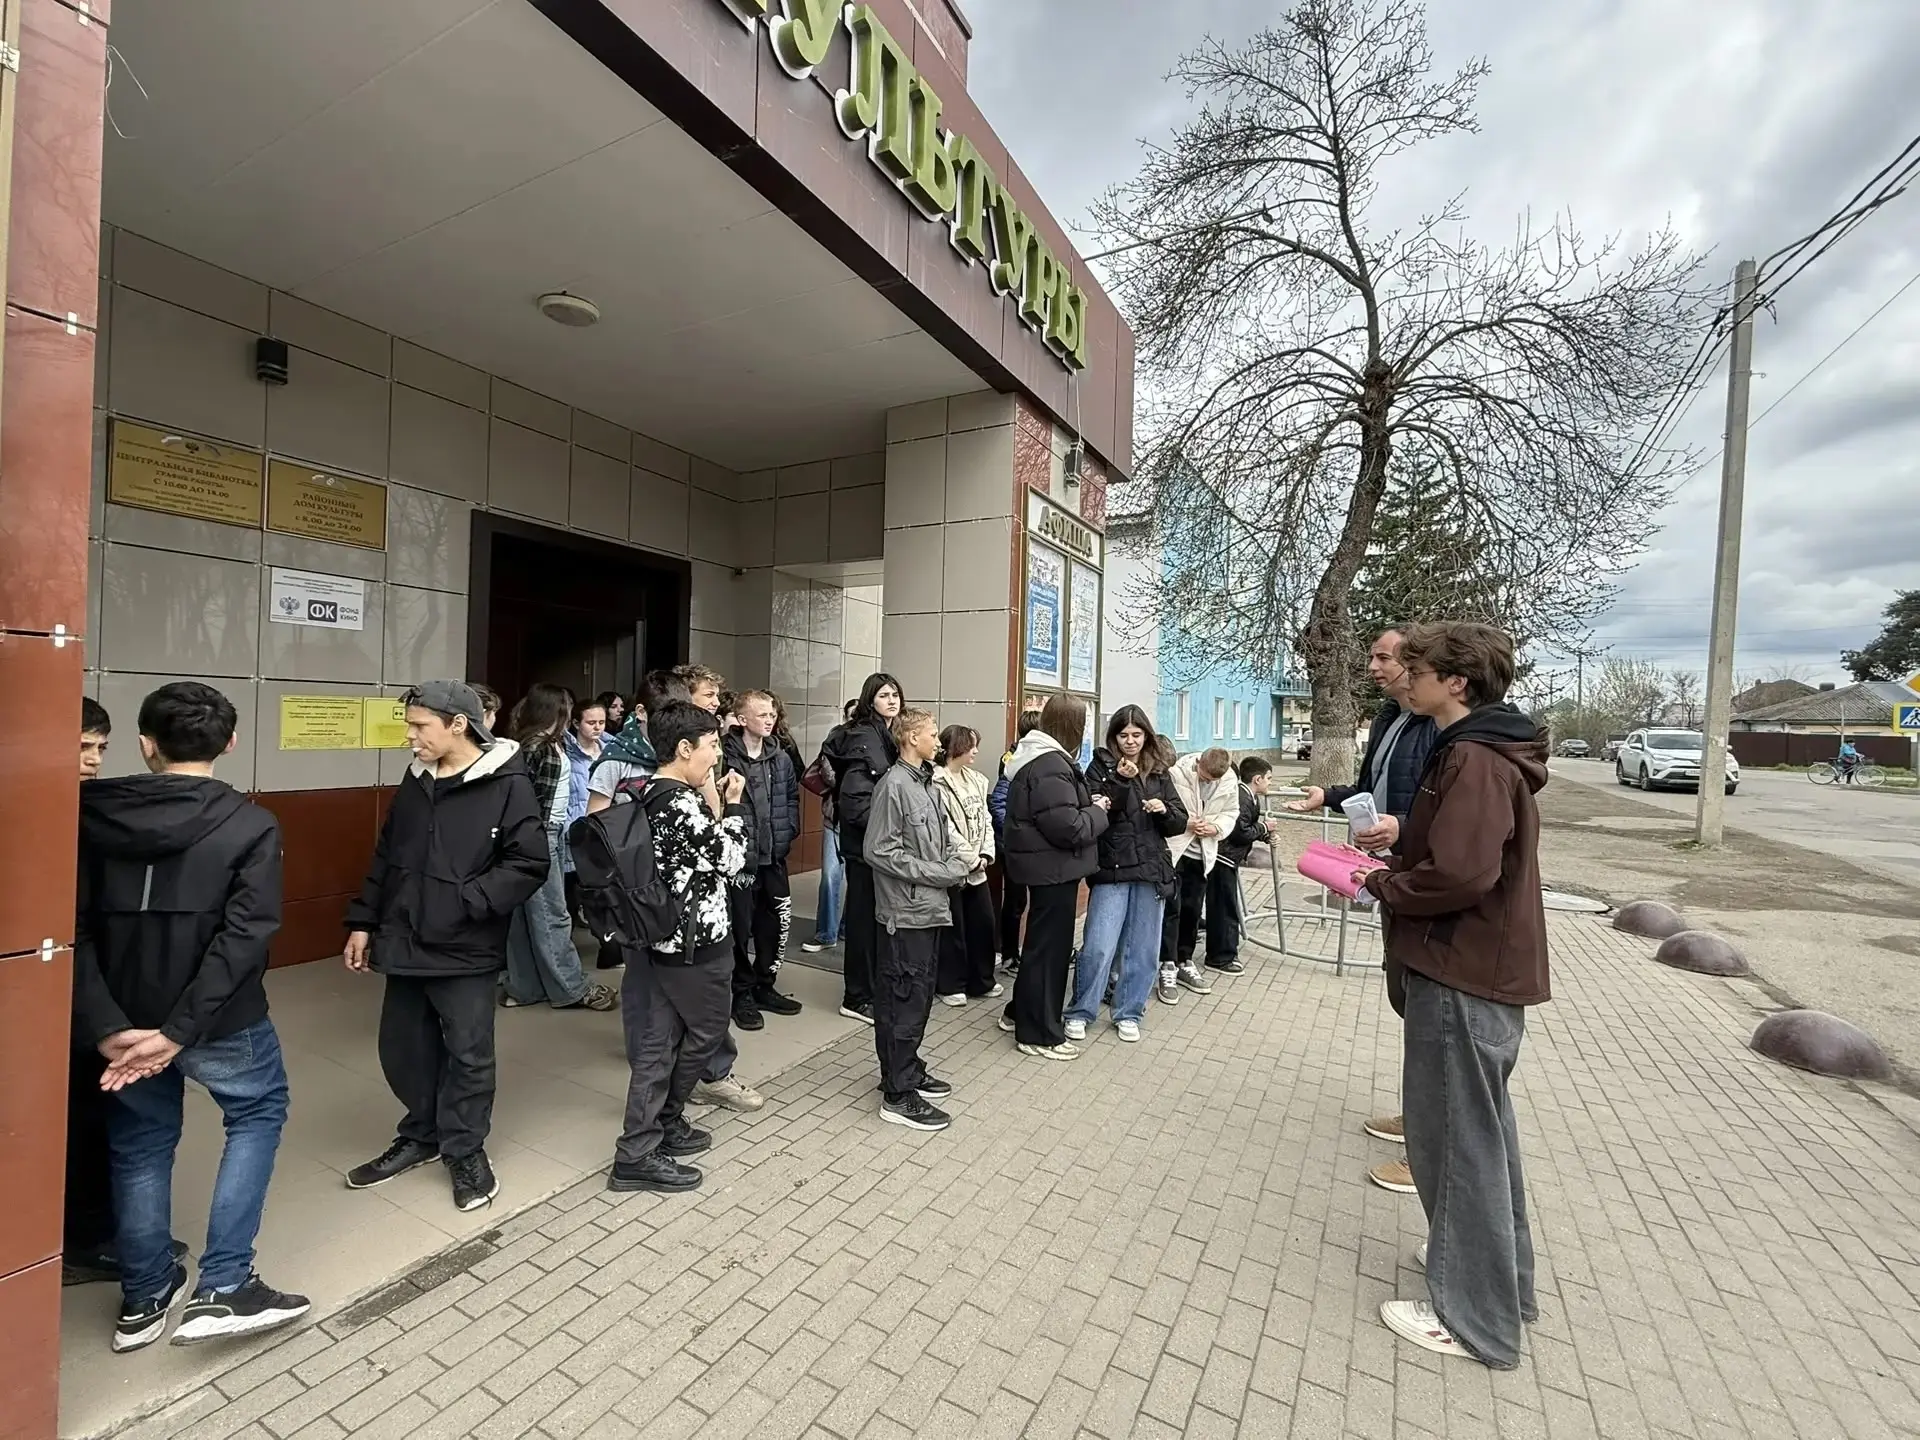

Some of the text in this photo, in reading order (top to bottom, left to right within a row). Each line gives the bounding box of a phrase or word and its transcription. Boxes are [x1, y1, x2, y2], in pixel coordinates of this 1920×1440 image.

[116, 452, 195, 474] ЦЕНТРАЛЬНАЯ
[195, 469, 259, 488] БИБЛИОТЕКА
[302, 492, 356, 510] РАЙОННЫЙ
[316, 504, 364, 519] КУЛЬТУРЫ
[1038, 505, 1093, 558] АФИША
[309, 603, 336, 620] ФК
[339, 606, 360, 615] ФОНД
